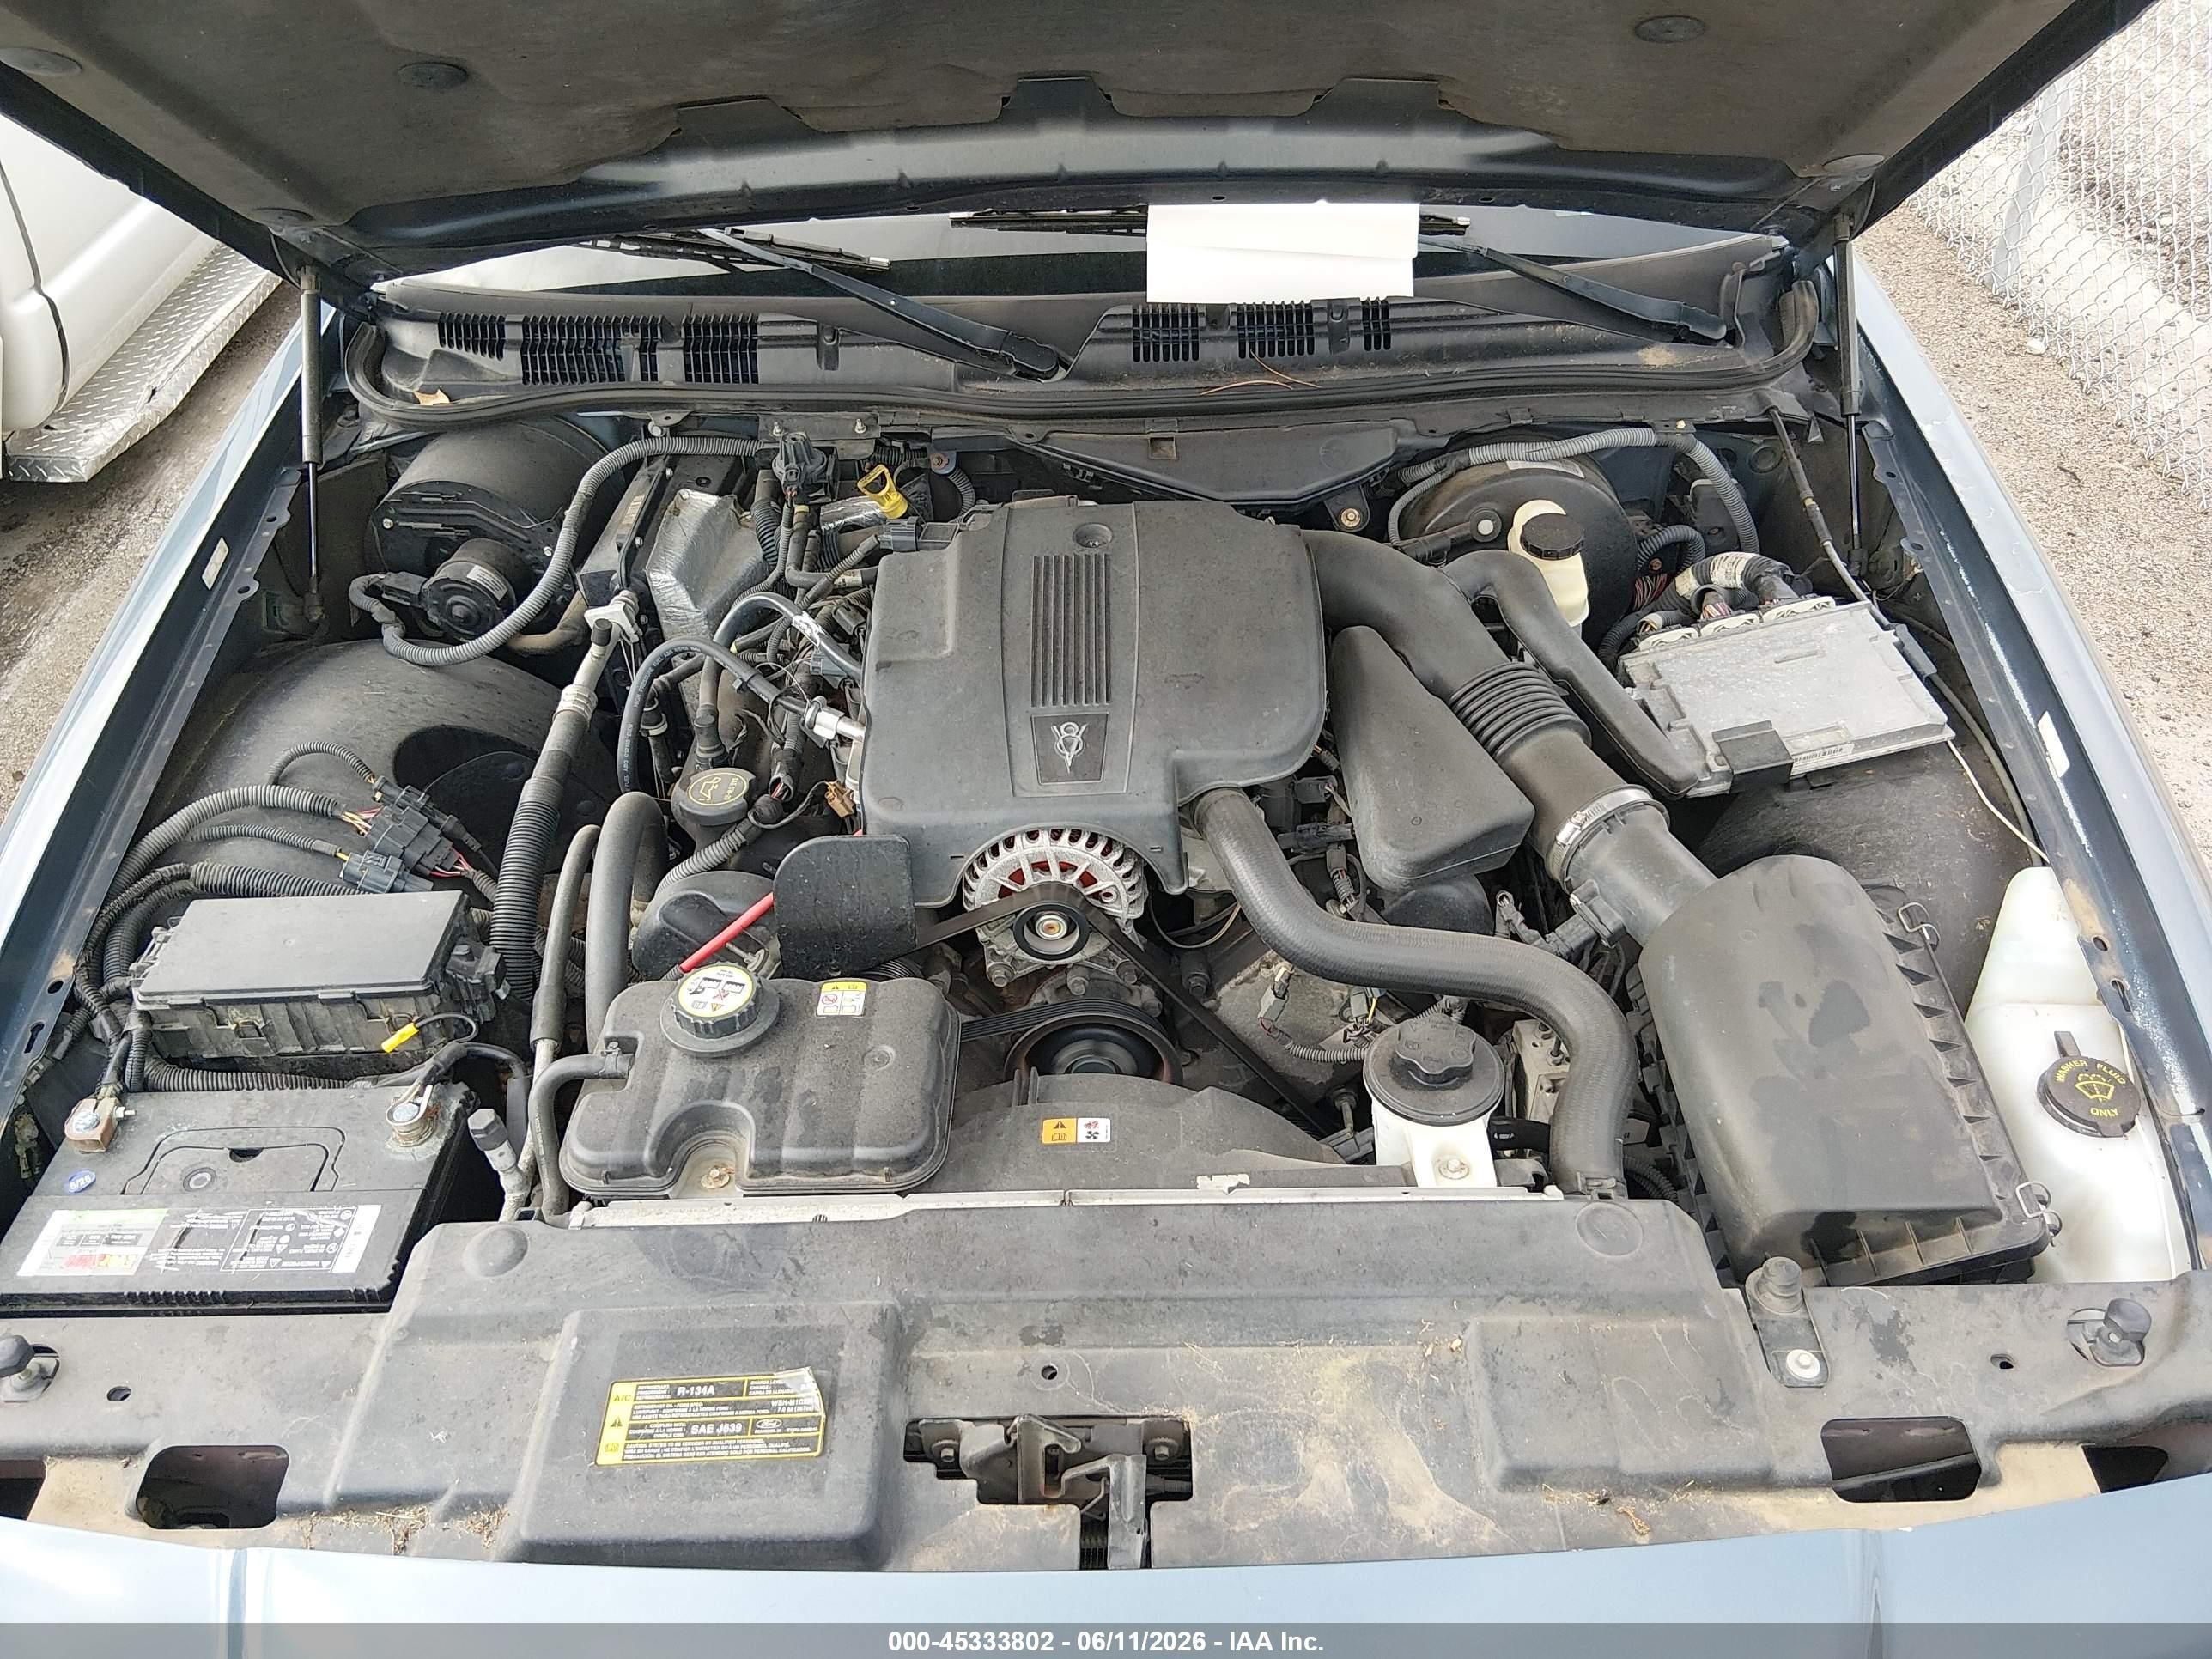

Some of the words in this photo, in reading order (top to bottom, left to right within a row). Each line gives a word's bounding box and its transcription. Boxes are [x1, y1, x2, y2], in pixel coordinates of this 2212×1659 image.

[2056, 1060, 2088, 1082] WASHER
[2096, 1063, 2126, 1085] FLUID
[2090, 1107, 2119, 1117] ONLY
[677, 1384, 715, 1397] R-134A
[613, 1394, 632, 1402] A/C
[690, 1424, 714, 1435] SAE
[716, 1422, 742, 1434] J639
